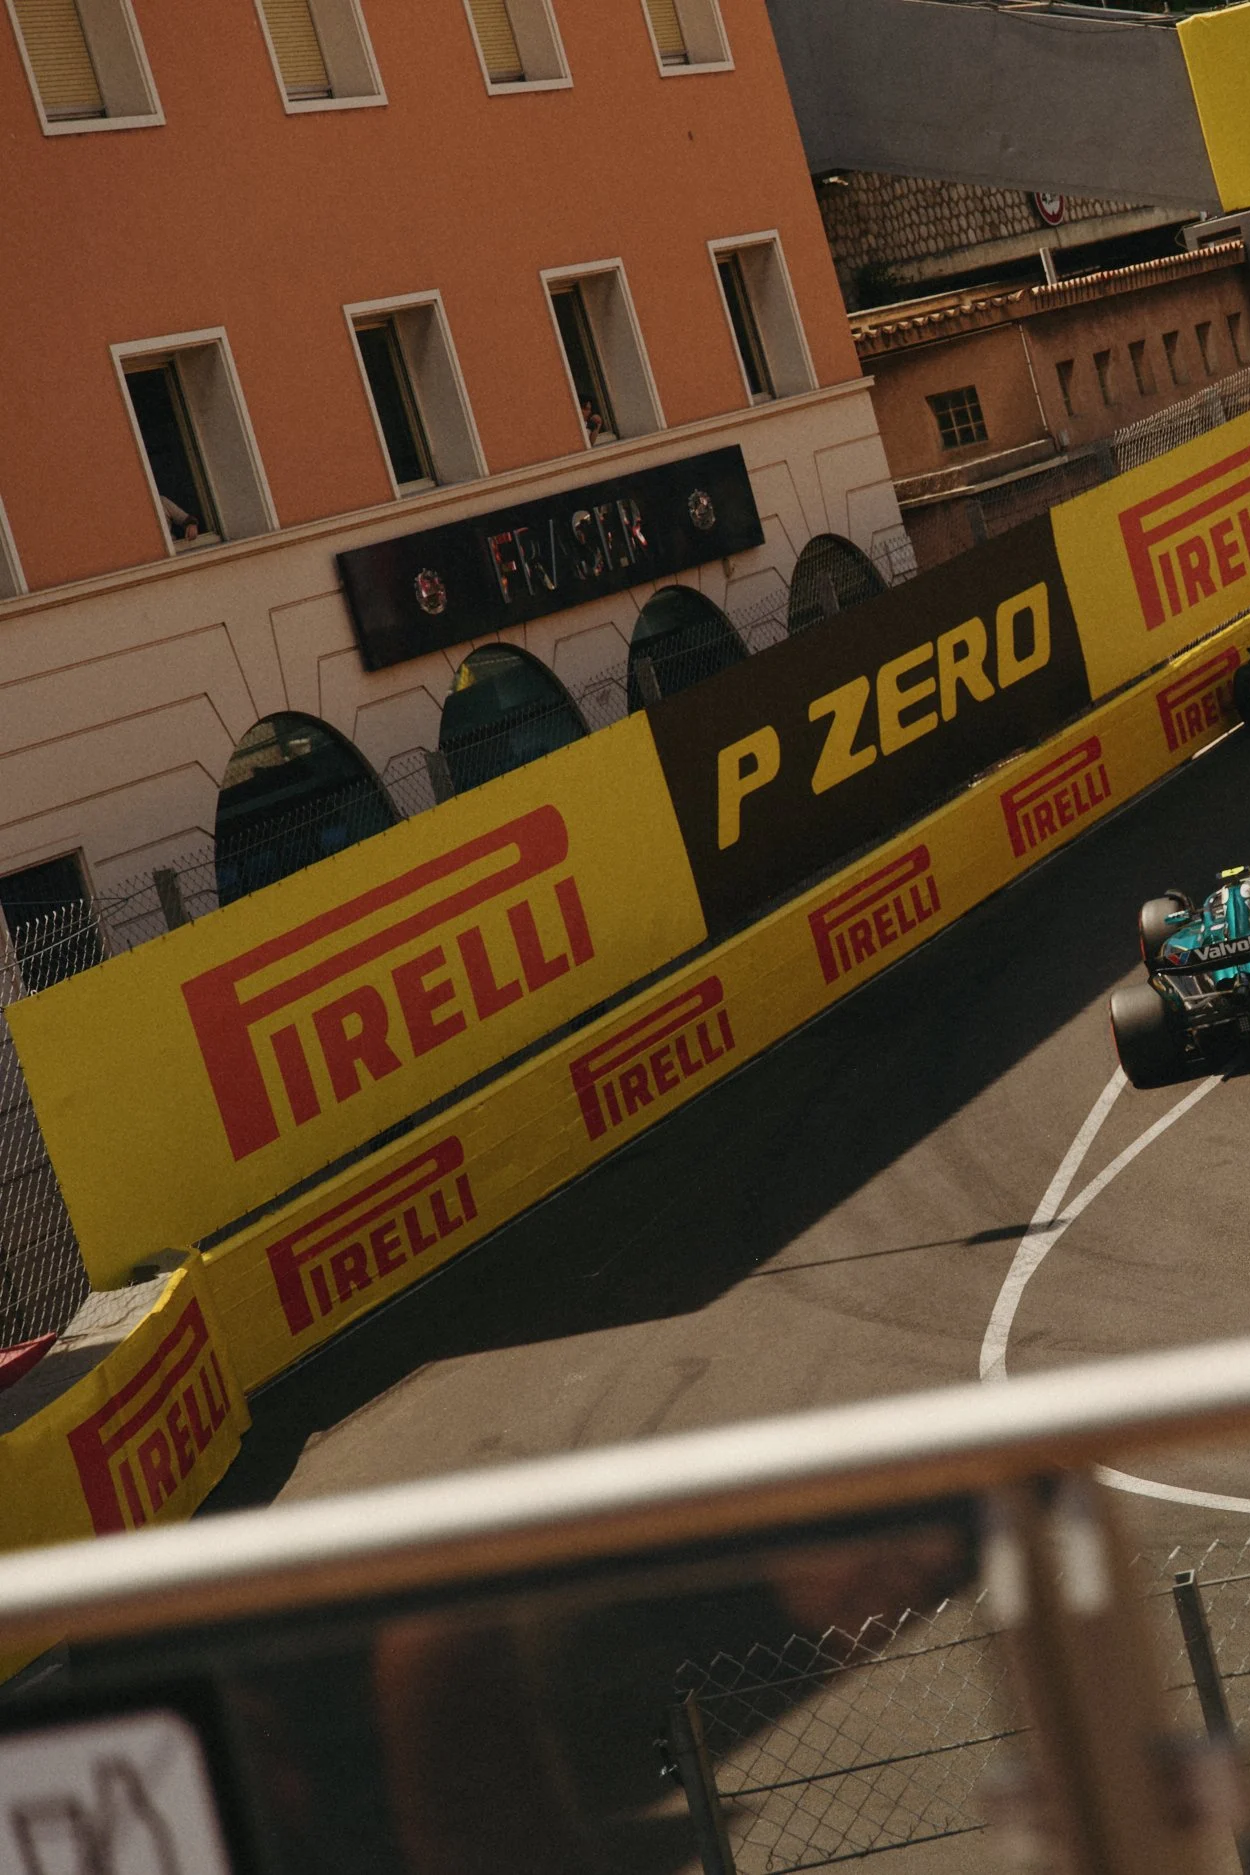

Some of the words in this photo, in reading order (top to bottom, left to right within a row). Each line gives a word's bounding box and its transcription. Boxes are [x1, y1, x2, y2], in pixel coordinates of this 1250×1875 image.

[718, 726, 780, 849] P
[809, 581, 1050, 795] ZERO
[999, 735, 1113, 859] PIRELLI
[181, 805, 595, 1160] PIRELLI
[807, 844, 941, 985] PIRELLI
[570, 973, 734, 1137] PIRELLI
[266, 1136, 478, 1336] PIRELLI
[68, 1297, 229, 1536] PIRELLI
